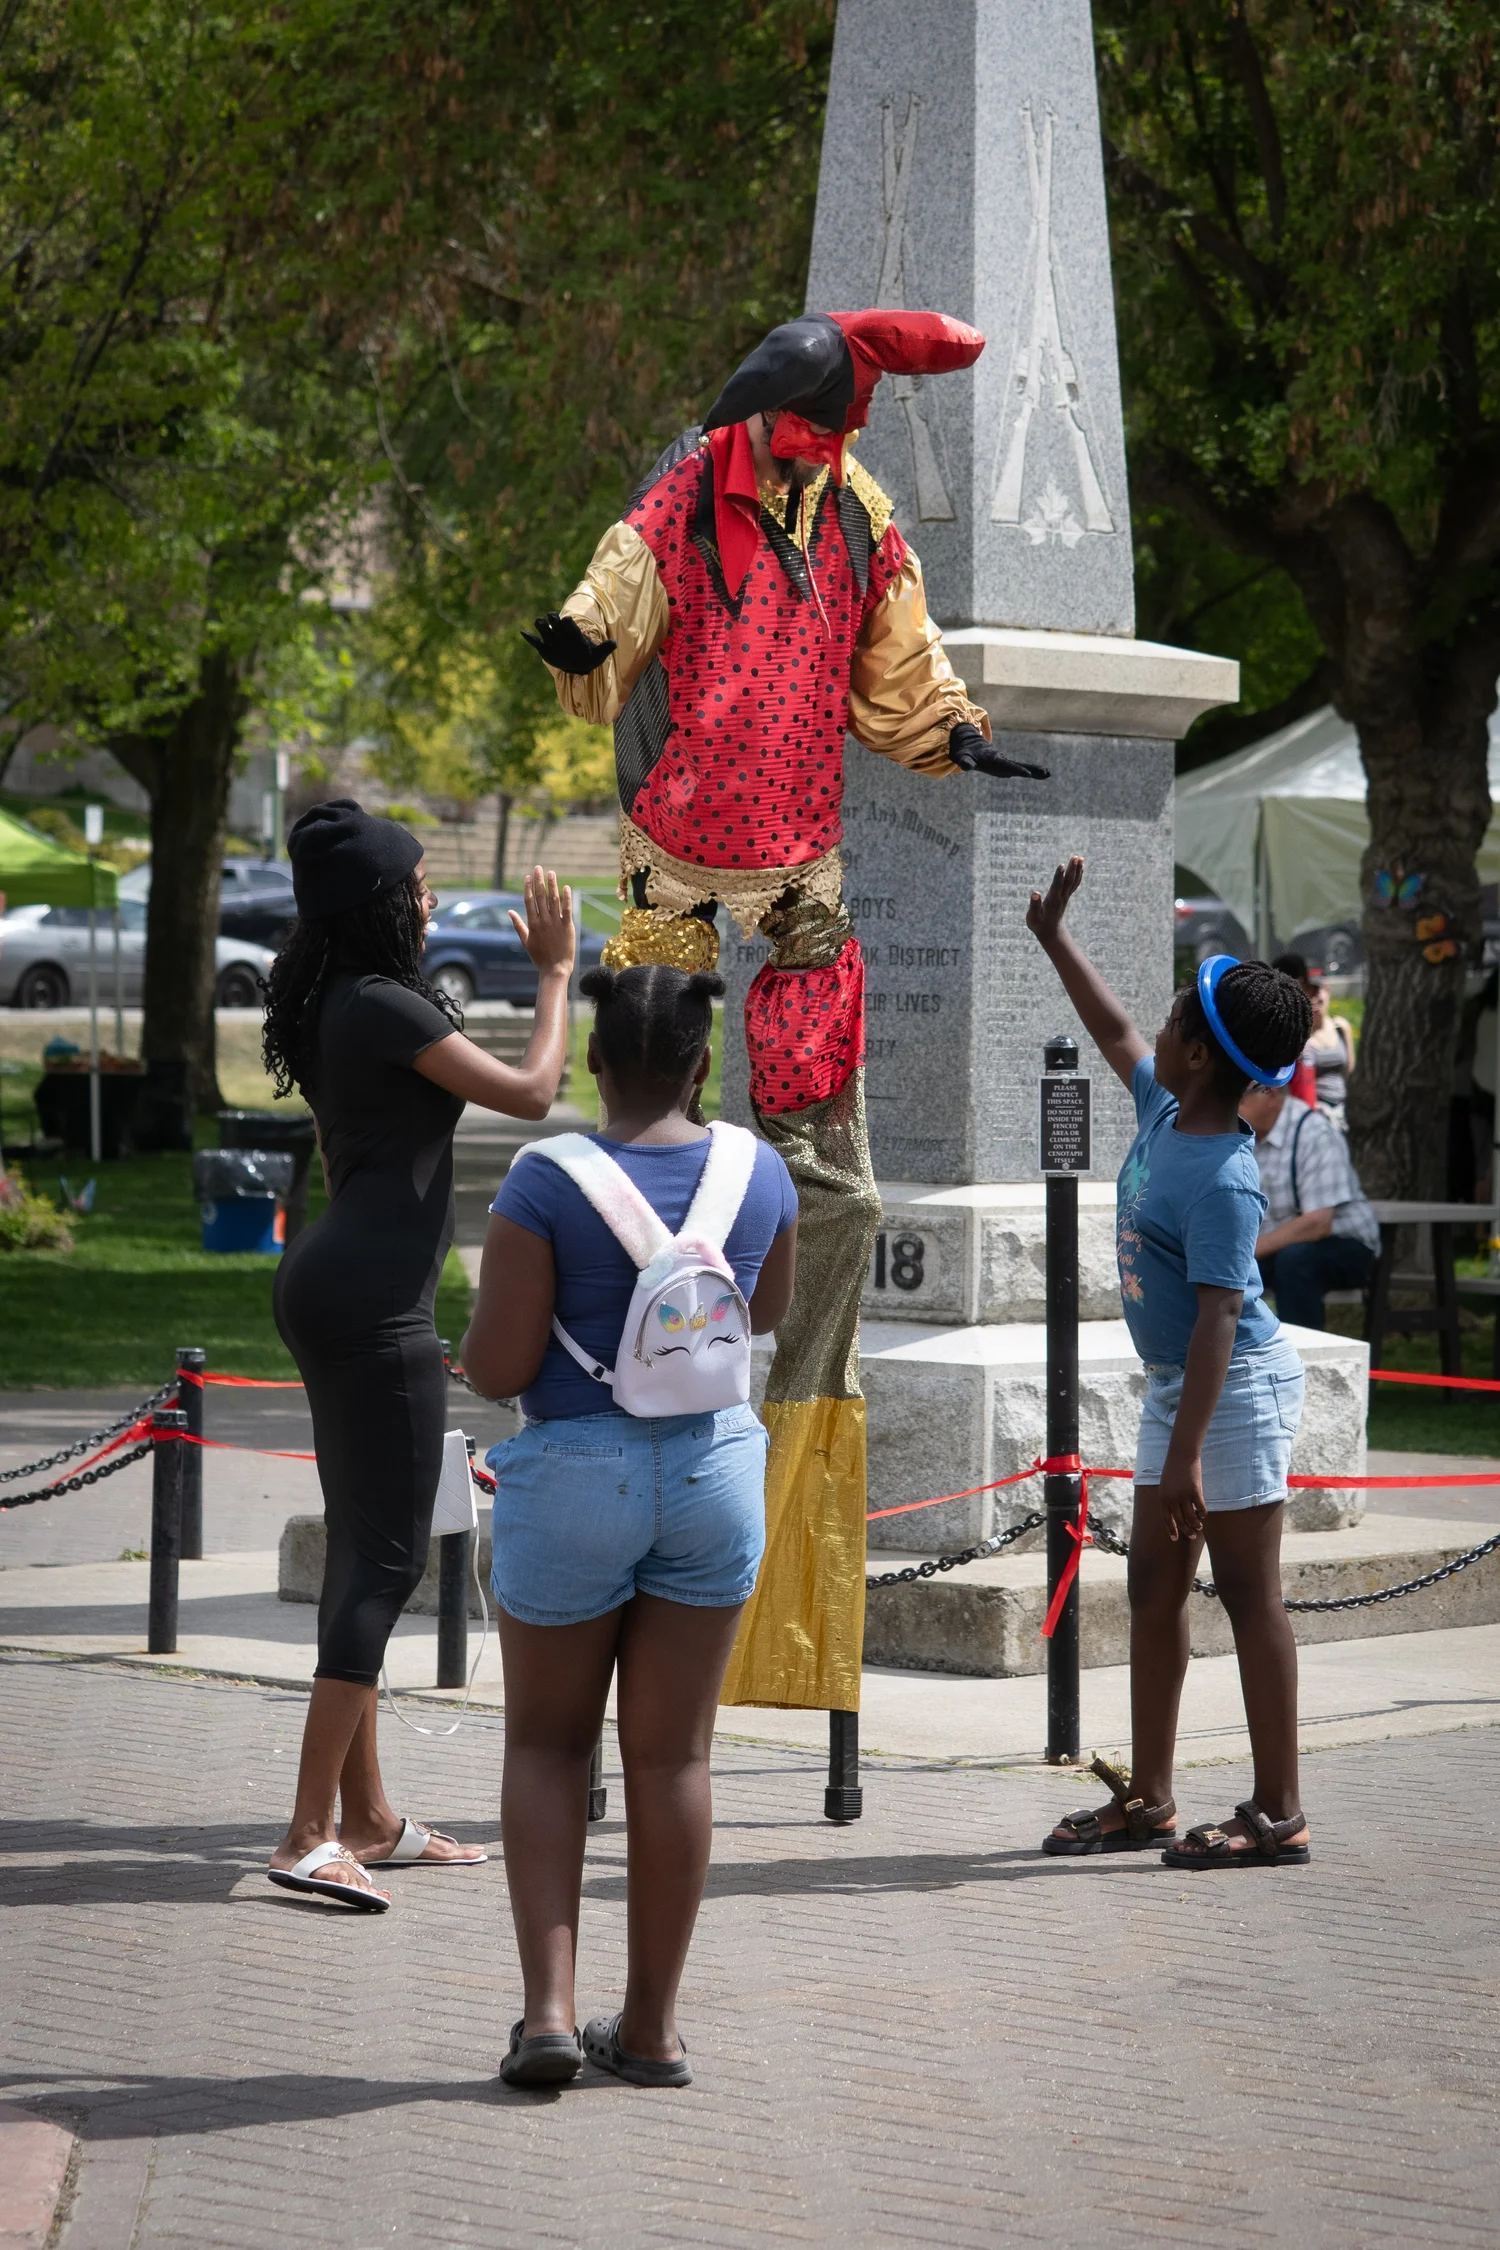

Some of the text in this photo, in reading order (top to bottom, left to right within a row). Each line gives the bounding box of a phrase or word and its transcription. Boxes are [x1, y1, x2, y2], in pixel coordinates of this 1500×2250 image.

[850, 897, 897, 919] BOYS
[861, 946, 881, 966] OK
[888, 944, 961, 967] DISTRICT
[864, 993, 941, 1013] EIR LIVES
[865, 1039, 897, 1058] RTY
[873, 1231, 925, 1292] 18
